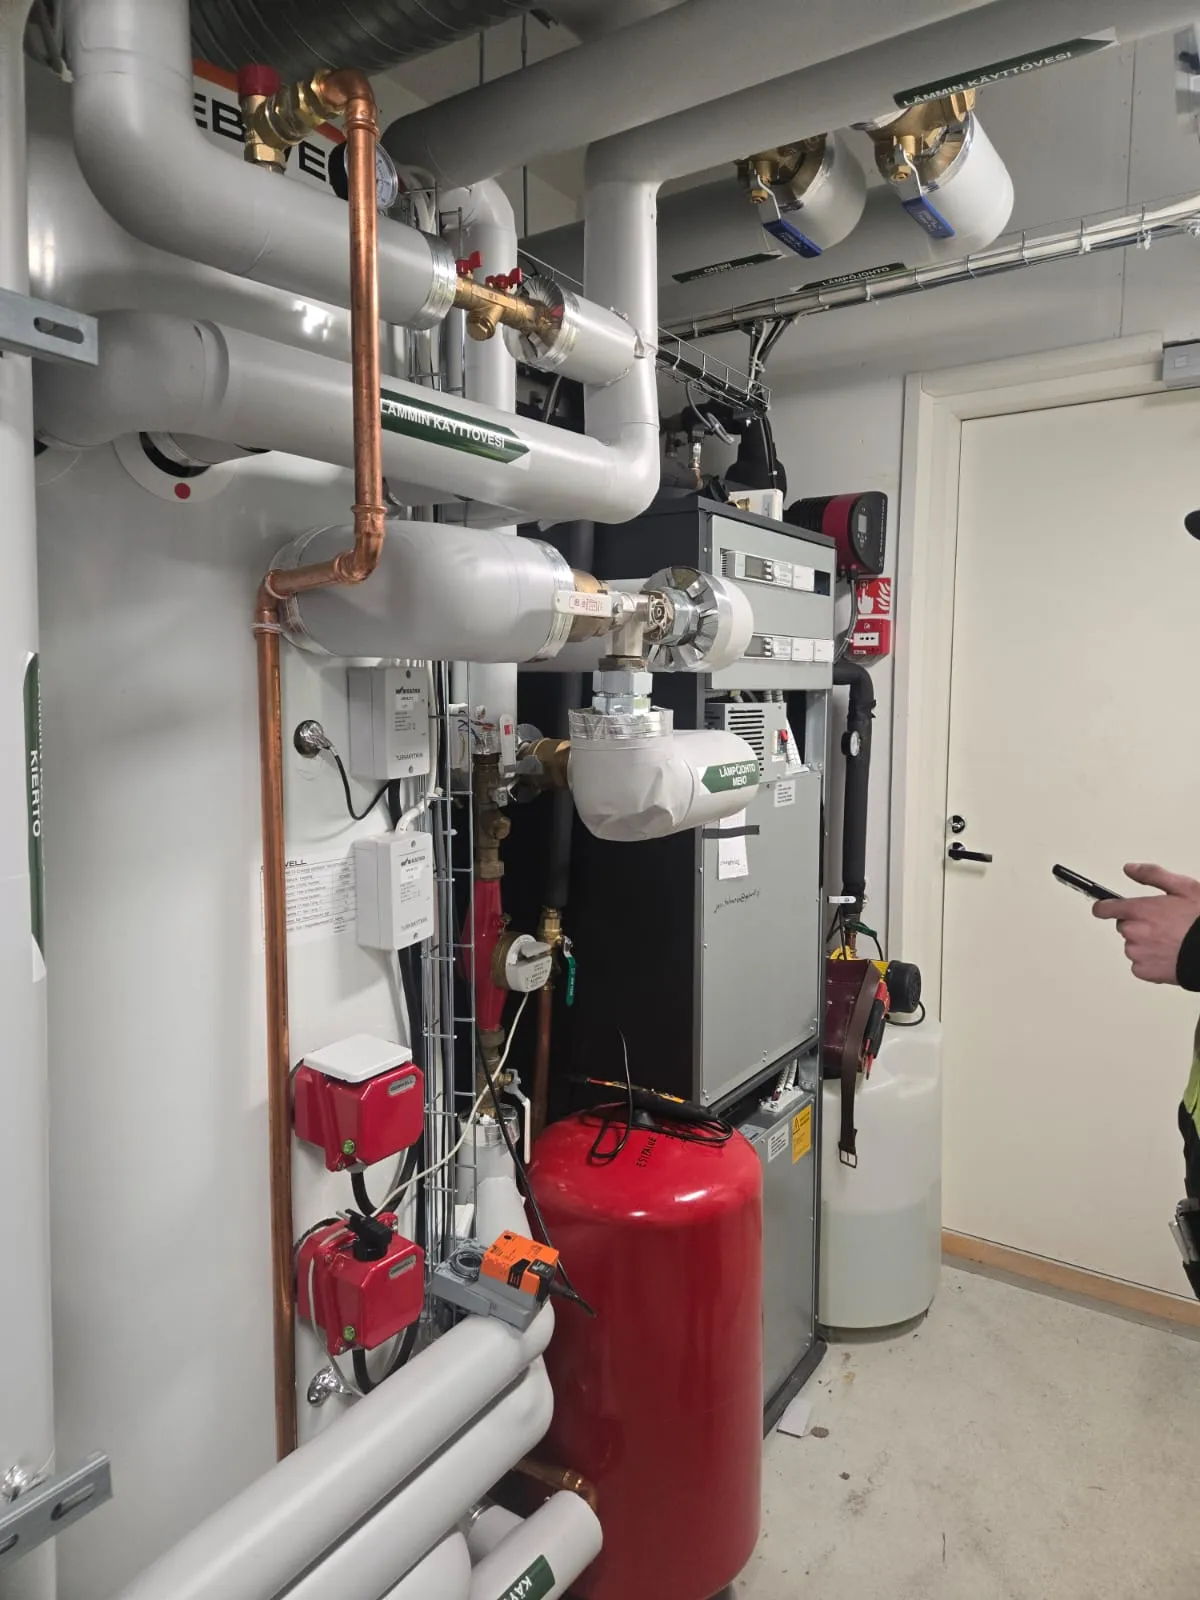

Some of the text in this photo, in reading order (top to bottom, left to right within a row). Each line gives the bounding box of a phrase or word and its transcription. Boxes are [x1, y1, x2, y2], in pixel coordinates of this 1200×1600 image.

[903, 50, 1073, 107] LÄMMIN KÄYTTÖVESI
[29, 749, 42, 838] KIERTO
[503, 1574, 533, 1600] KÄY
